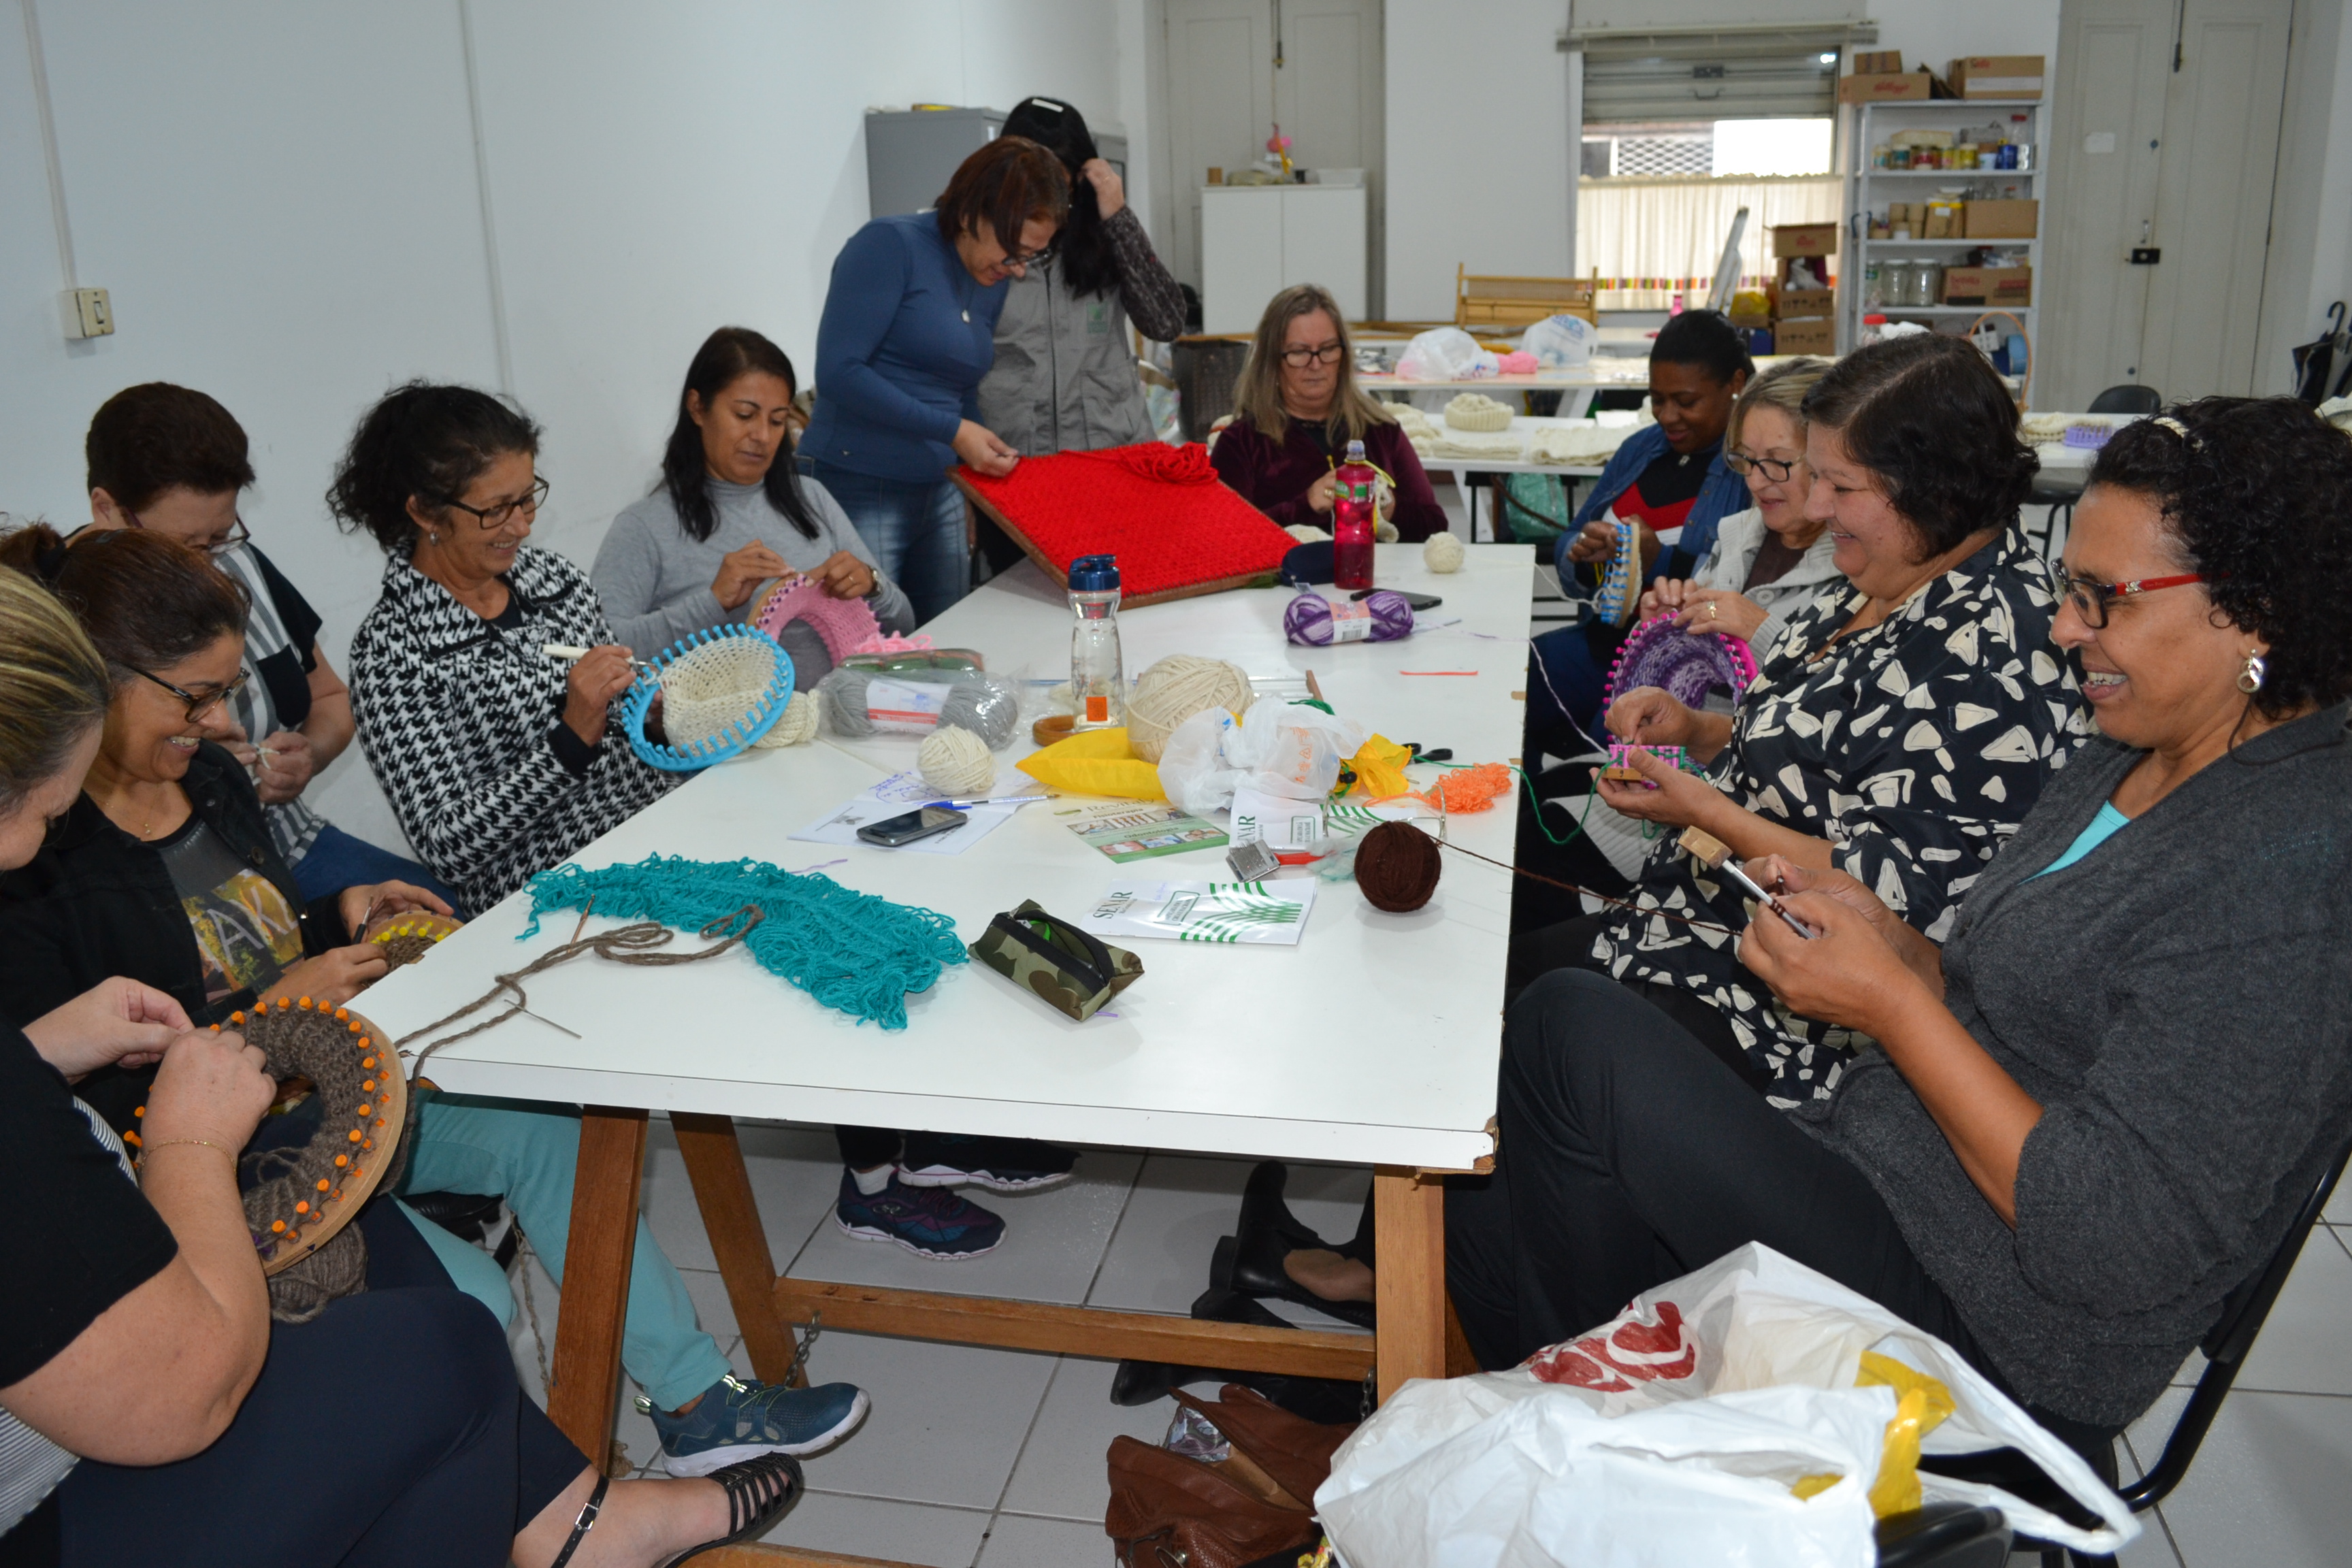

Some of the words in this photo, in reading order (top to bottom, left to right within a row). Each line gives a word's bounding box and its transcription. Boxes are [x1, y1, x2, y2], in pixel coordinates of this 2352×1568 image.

[1093, 808, 1144, 819] Fisioterapia
[1124, 826, 1179, 838] Odontologia
[1237, 815, 1256, 841] NAR
[1092, 892, 1133, 919] SENAR
